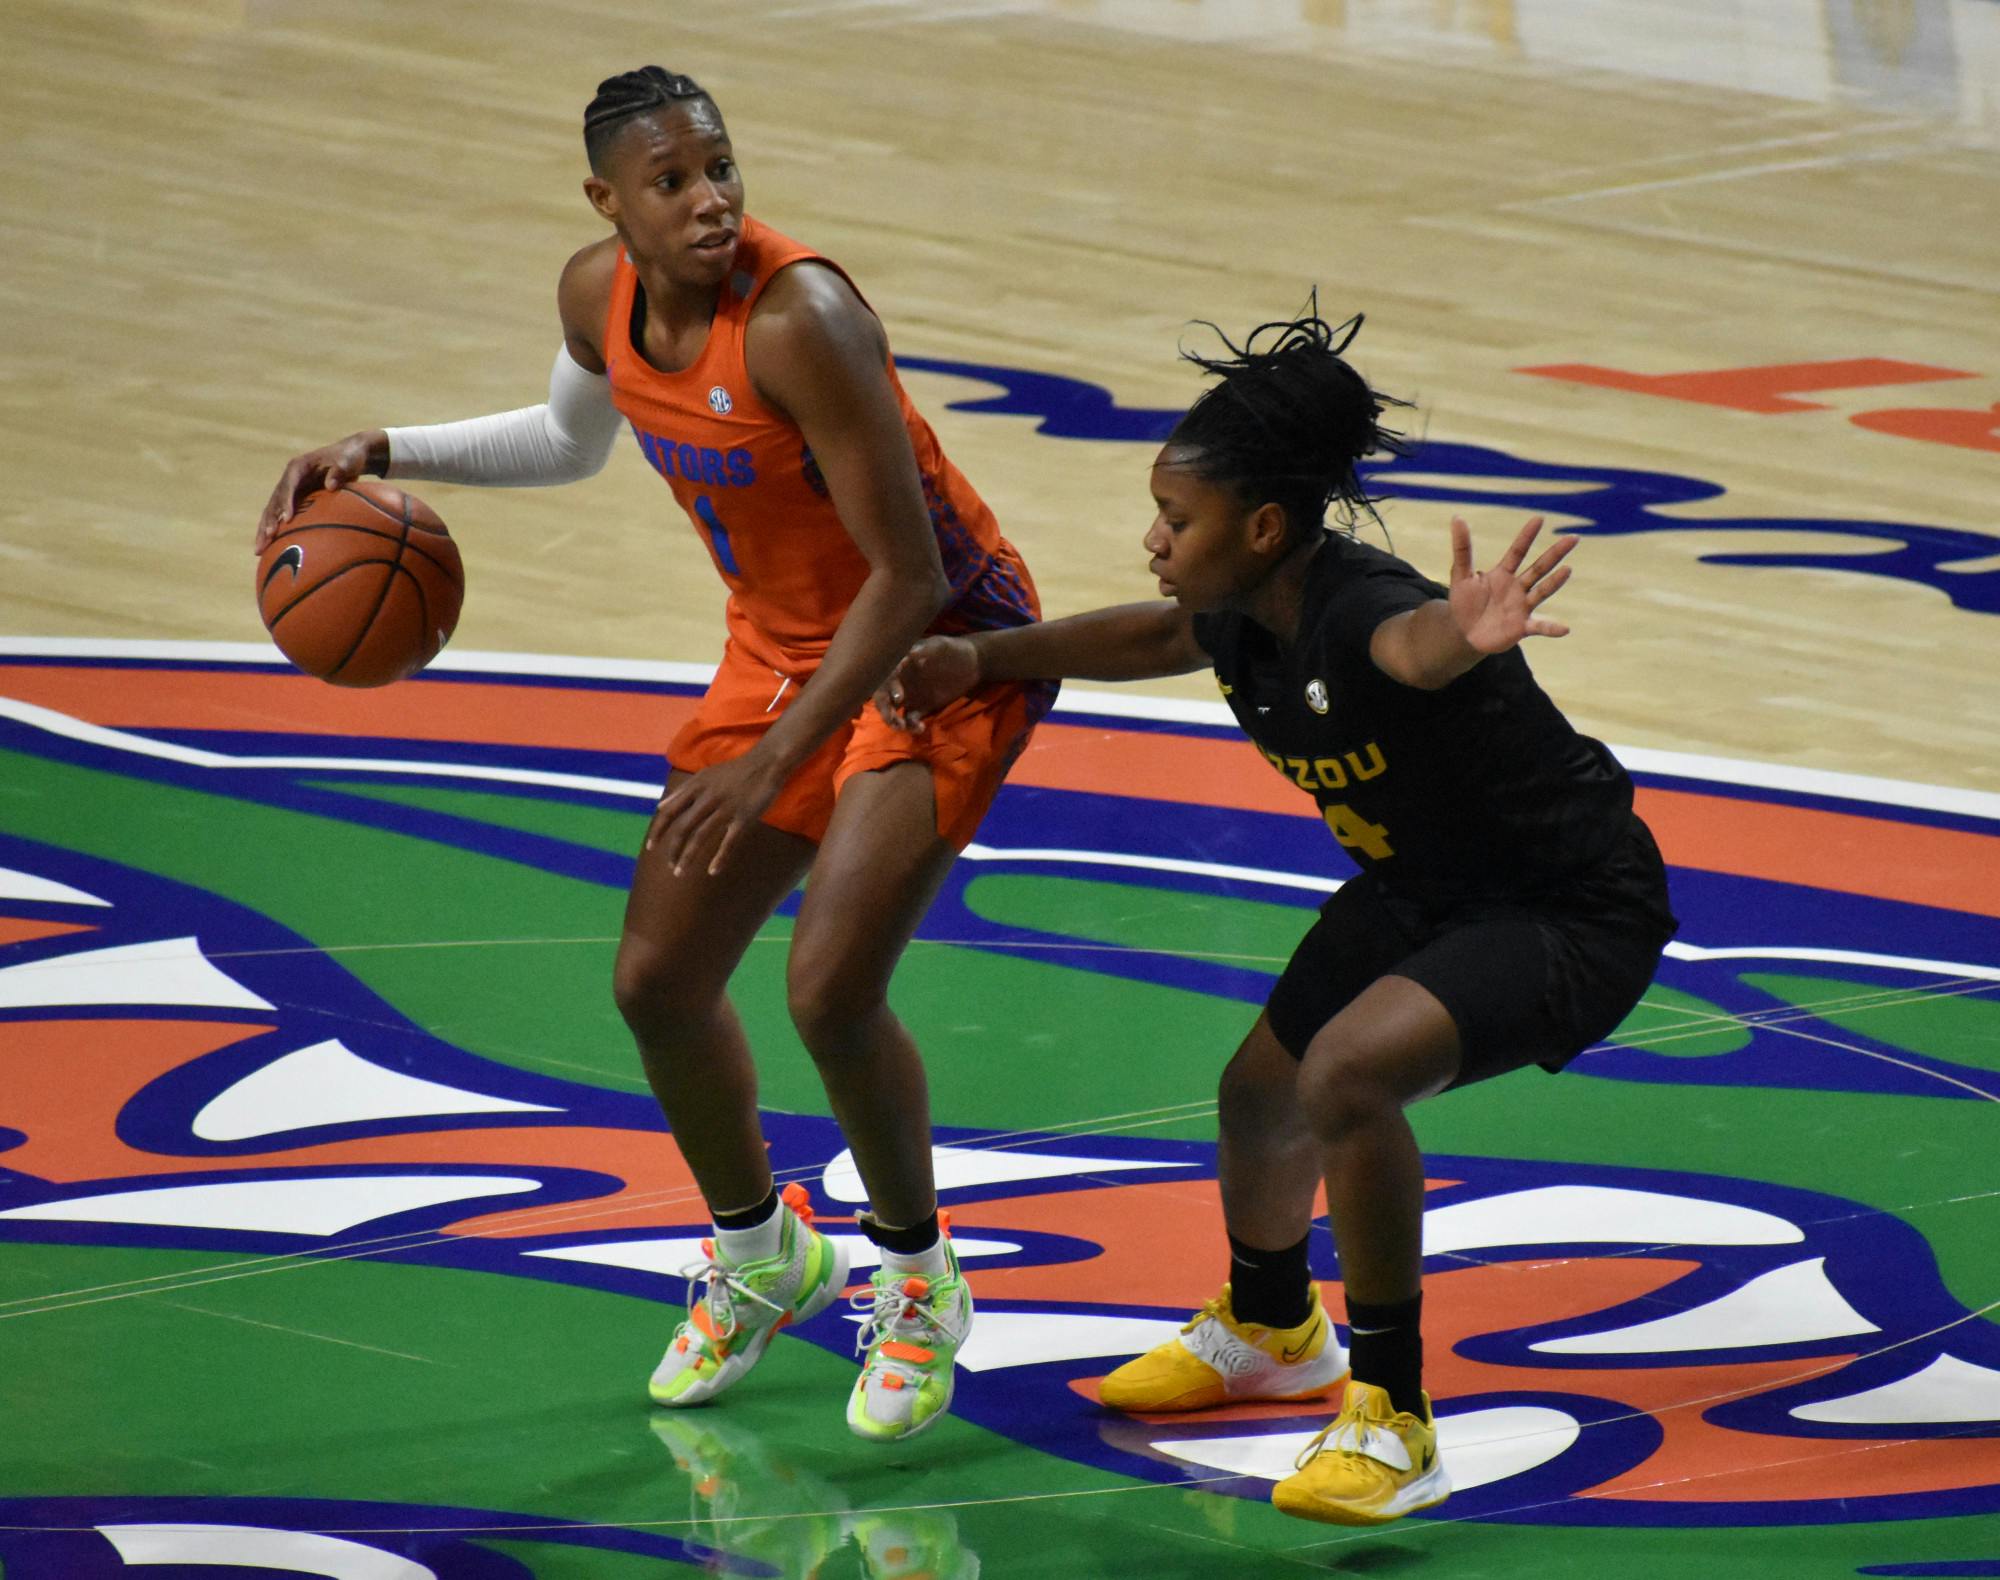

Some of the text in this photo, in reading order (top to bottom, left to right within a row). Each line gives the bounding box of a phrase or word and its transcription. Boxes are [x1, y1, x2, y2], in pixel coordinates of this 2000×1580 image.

[631, 425, 756, 488] ATORS
[694, 495, 740, 576] 1
[1258, 742, 1387, 789] ZOU
[1324, 803, 1395, 860] 4
